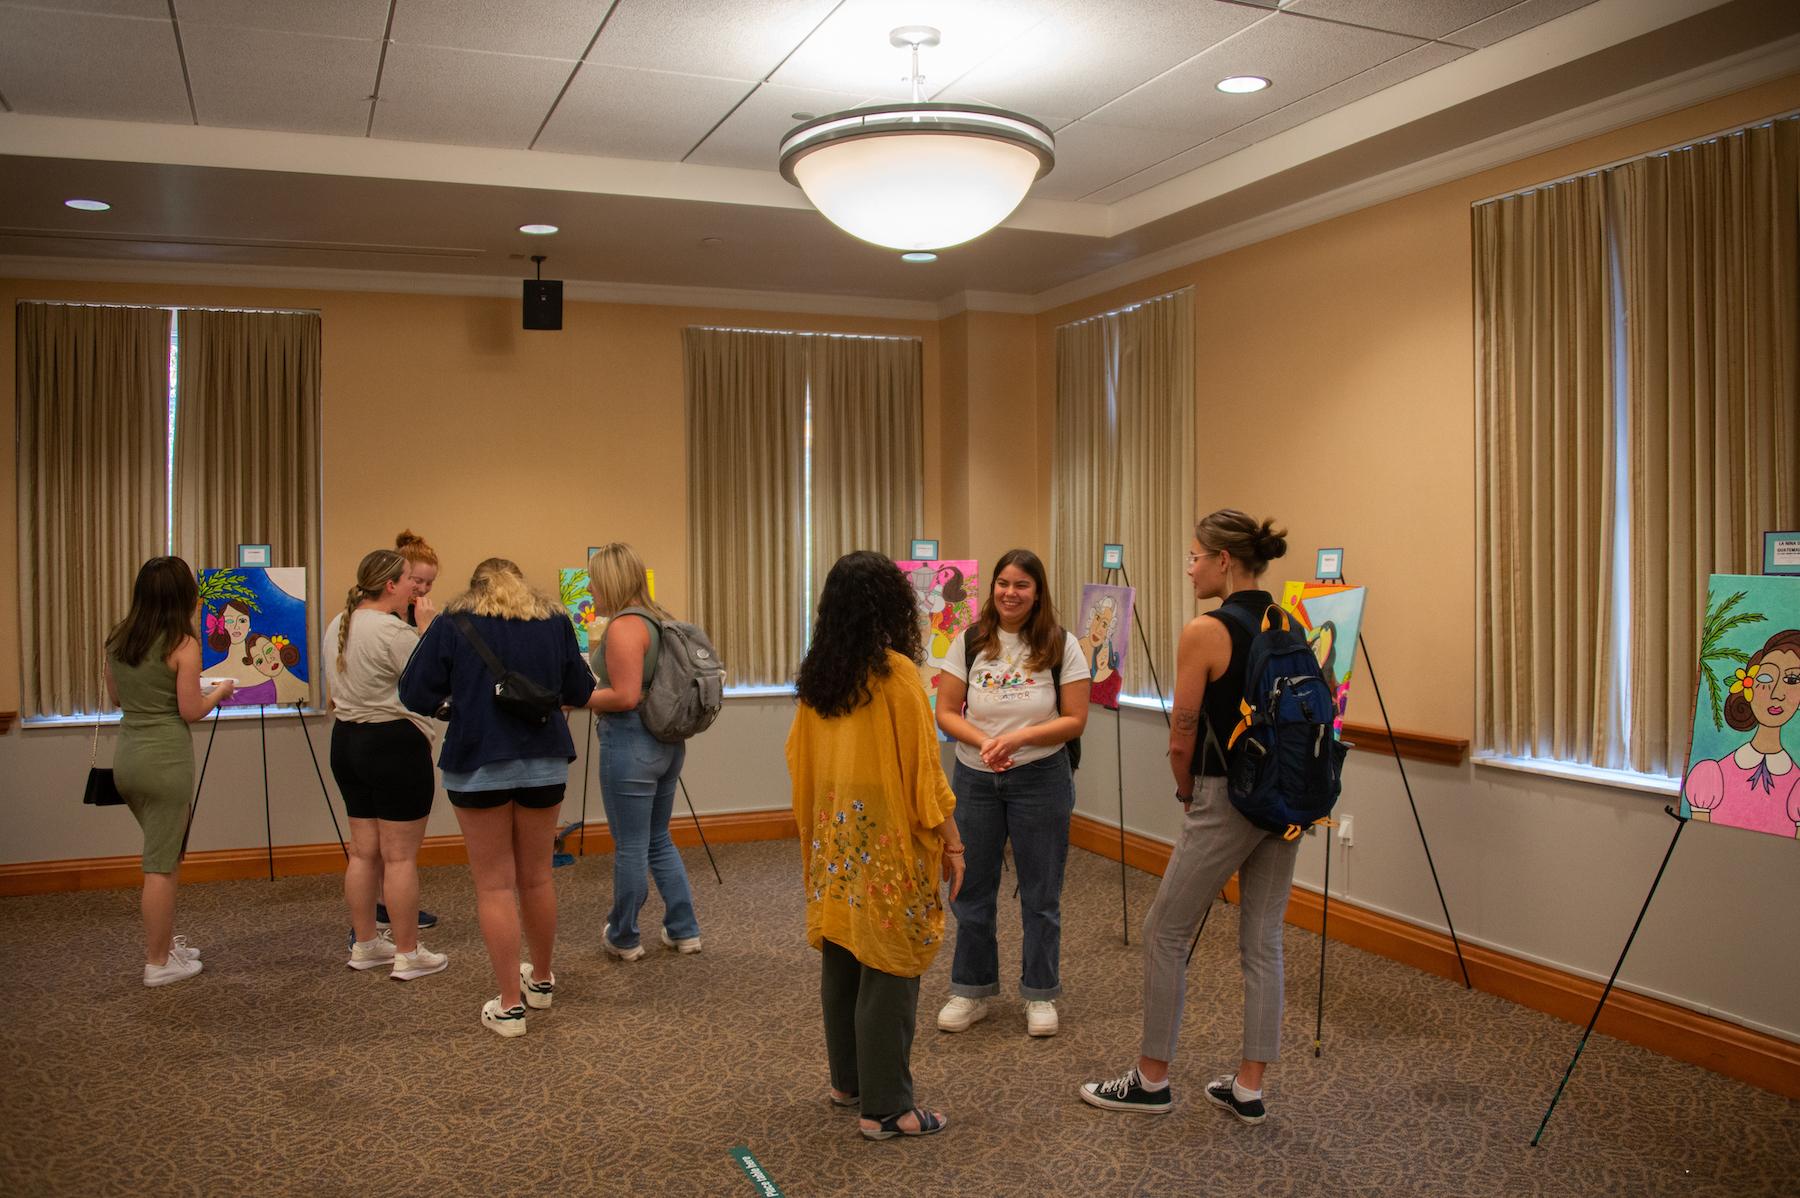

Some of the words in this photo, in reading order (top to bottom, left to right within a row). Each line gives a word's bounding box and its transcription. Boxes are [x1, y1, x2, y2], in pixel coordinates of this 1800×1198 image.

[742, 1156, 757, 1169] here
[750, 1167, 767, 1182] table
[761, 1181, 779, 1197] Place
